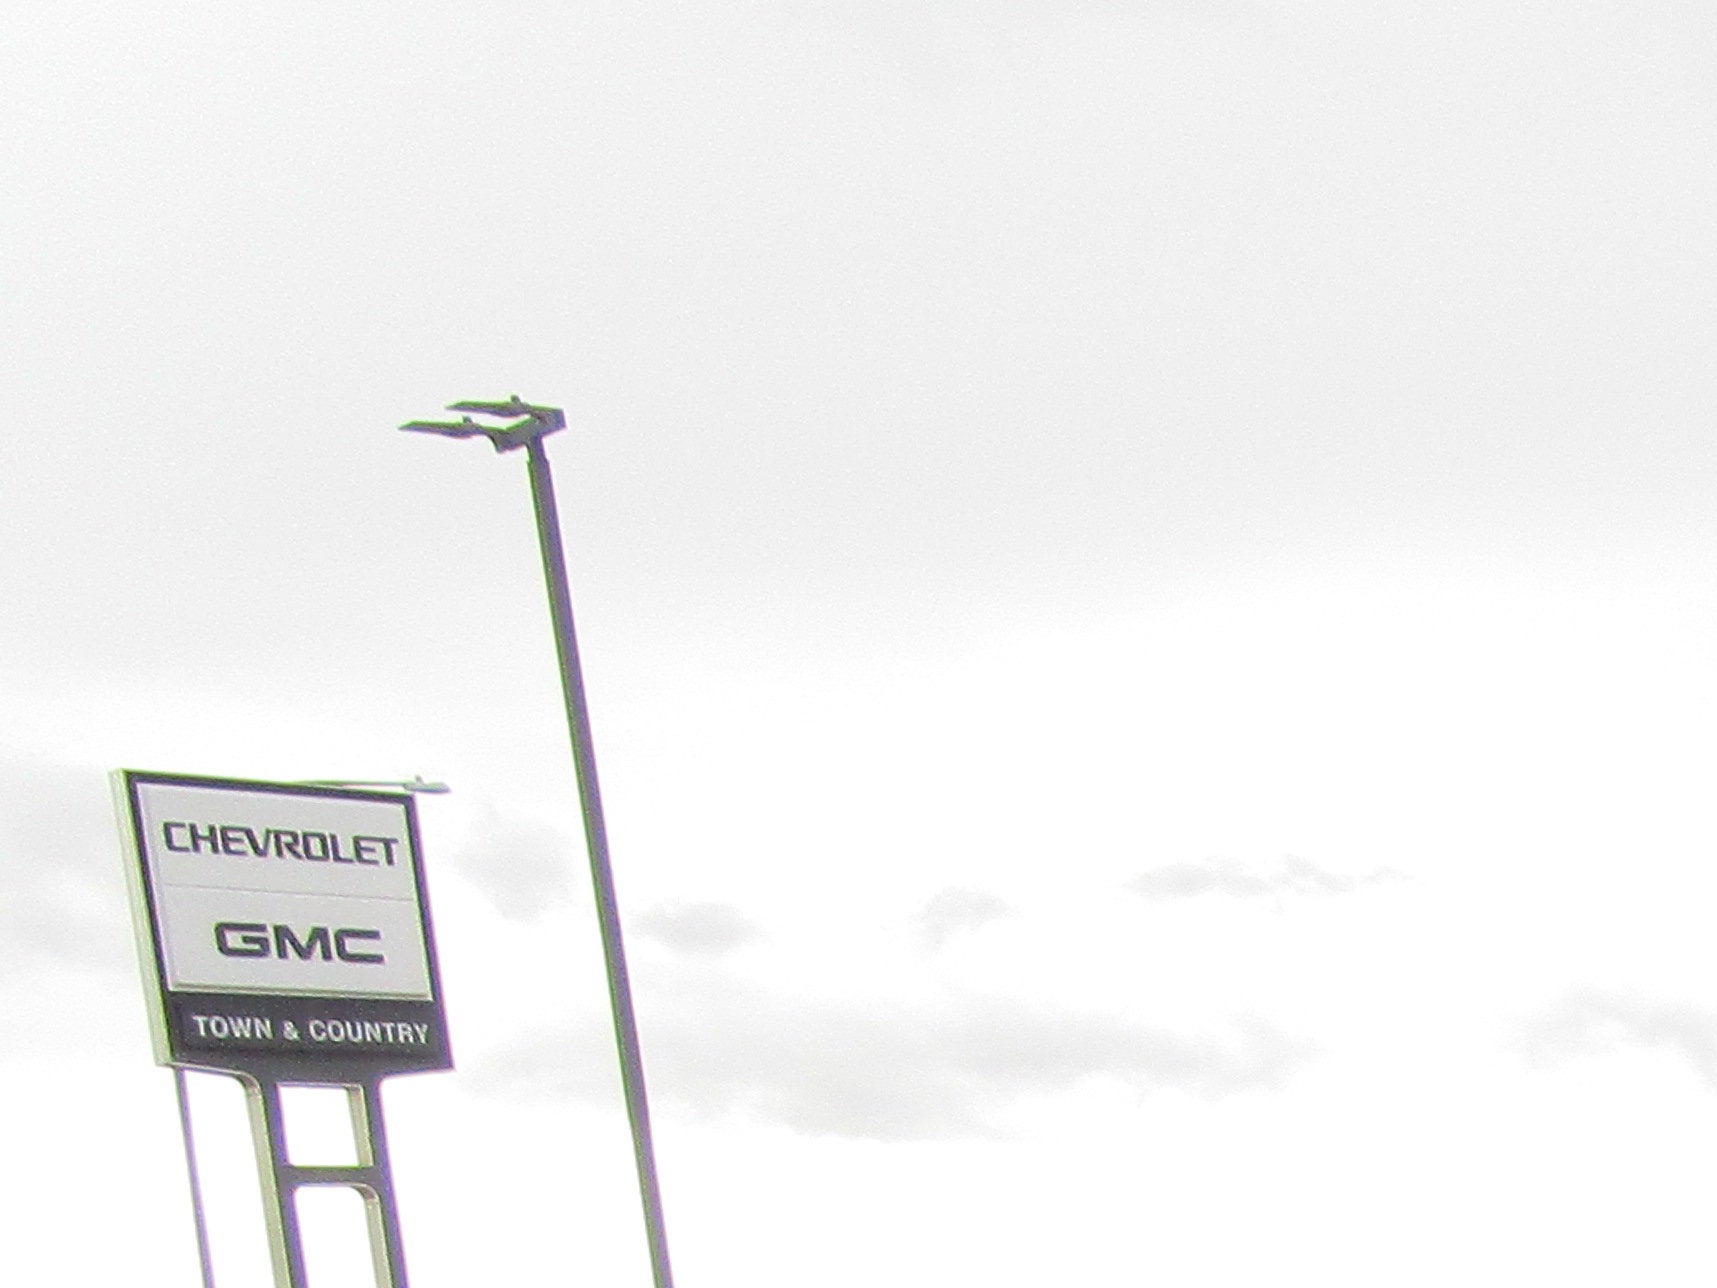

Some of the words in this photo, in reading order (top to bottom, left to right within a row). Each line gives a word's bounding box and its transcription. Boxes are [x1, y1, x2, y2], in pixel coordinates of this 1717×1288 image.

[162, 821, 399, 866] CHEVROLET
[214, 921, 386, 965] GMC
[193, 1014, 273, 1040] TOWN
[282, 1019, 301, 1041] &
[308, 1018, 430, 1045] COUNTRY
